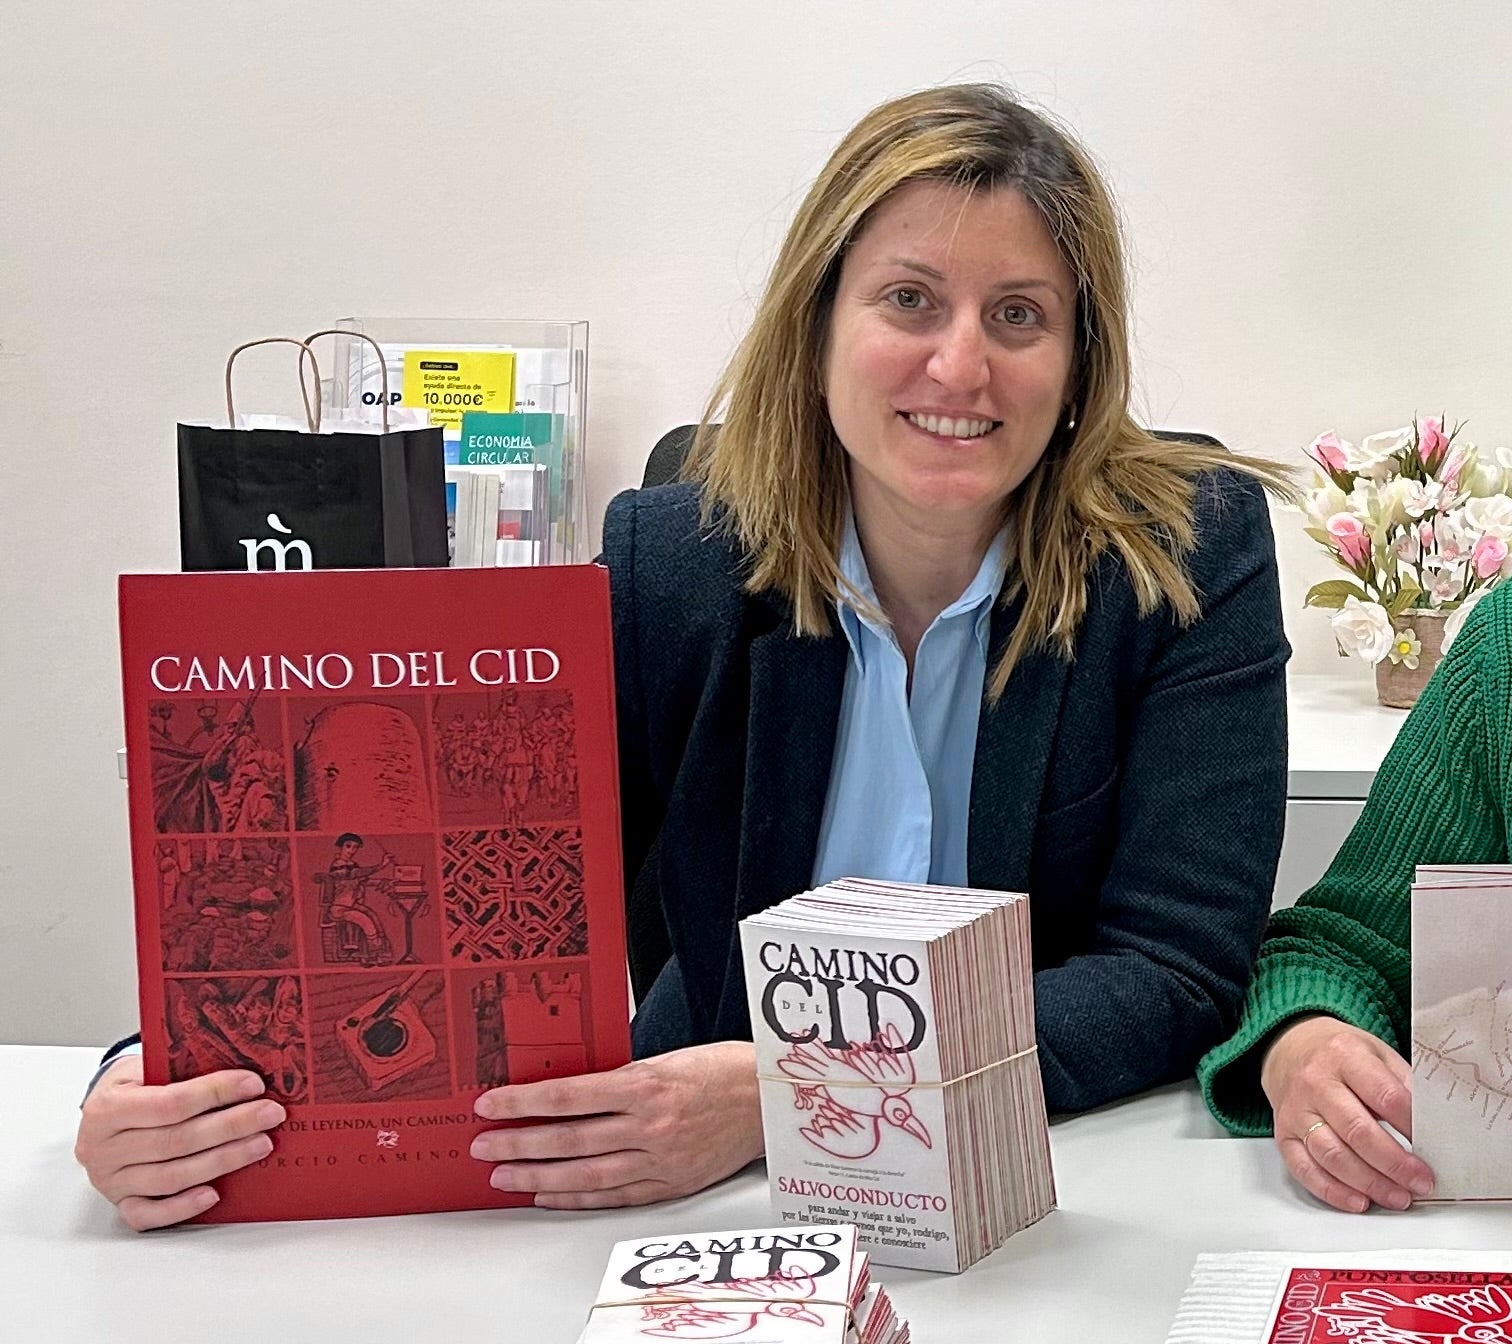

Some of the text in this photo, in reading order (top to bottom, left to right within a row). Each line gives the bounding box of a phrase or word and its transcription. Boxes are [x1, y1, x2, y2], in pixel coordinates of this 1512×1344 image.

[423, 392, 484, 406] 10.000€
[468, 434, 534, 449] ECONOMIA
[150, 647, 561, 693] CAMINO DEL CID
[759, 941, 920, 986] CAMINO
[761, 972, 926, 1054] CID
[782, 999, 823, 1015] DEL
[289, 1120, 308, 1132] DE
[380, 1117, 401, 1129] UN
[406, 1113, 467, 1128] CAMINO
[358, 1148, 460, 1165] CAMINO
[778, 1176, 947, 1212] SALVOCONDUCTO
[634, 1232, 842, 1259] CAMINO
[620, 1246, 841, 1289] CID
